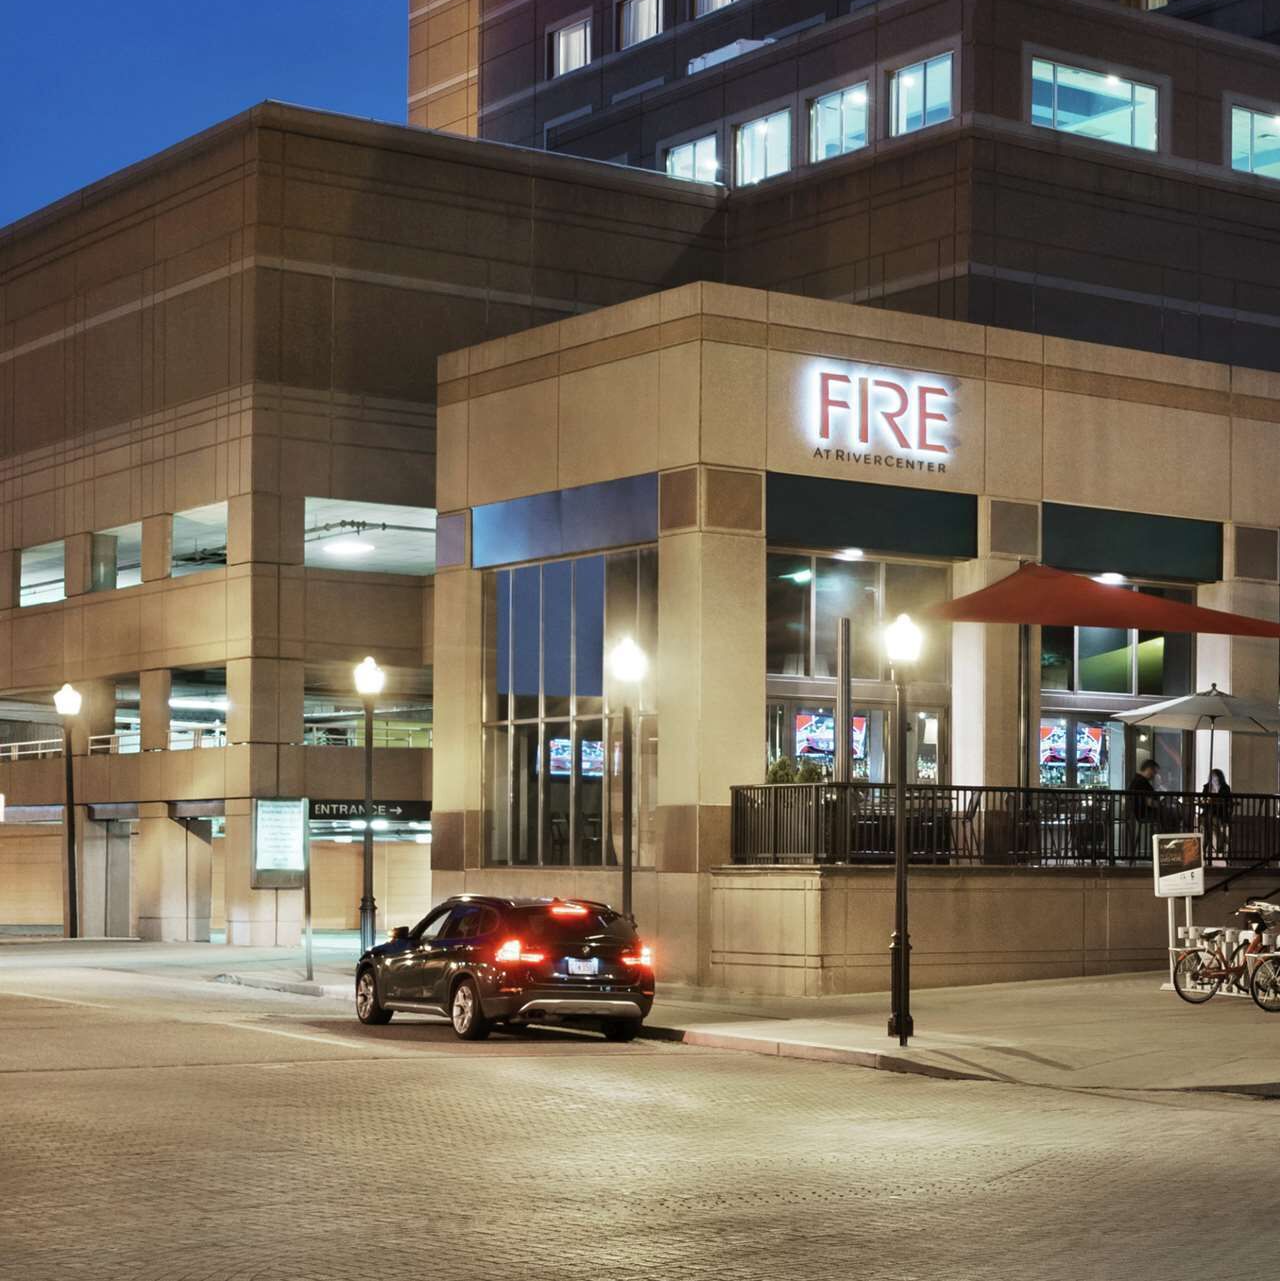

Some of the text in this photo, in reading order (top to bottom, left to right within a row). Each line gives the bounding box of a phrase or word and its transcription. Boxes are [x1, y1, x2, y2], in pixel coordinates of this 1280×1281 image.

[819, 372, 949, 454] FIRE
[813, 447, 946, 473] AT RIVERCENTER
